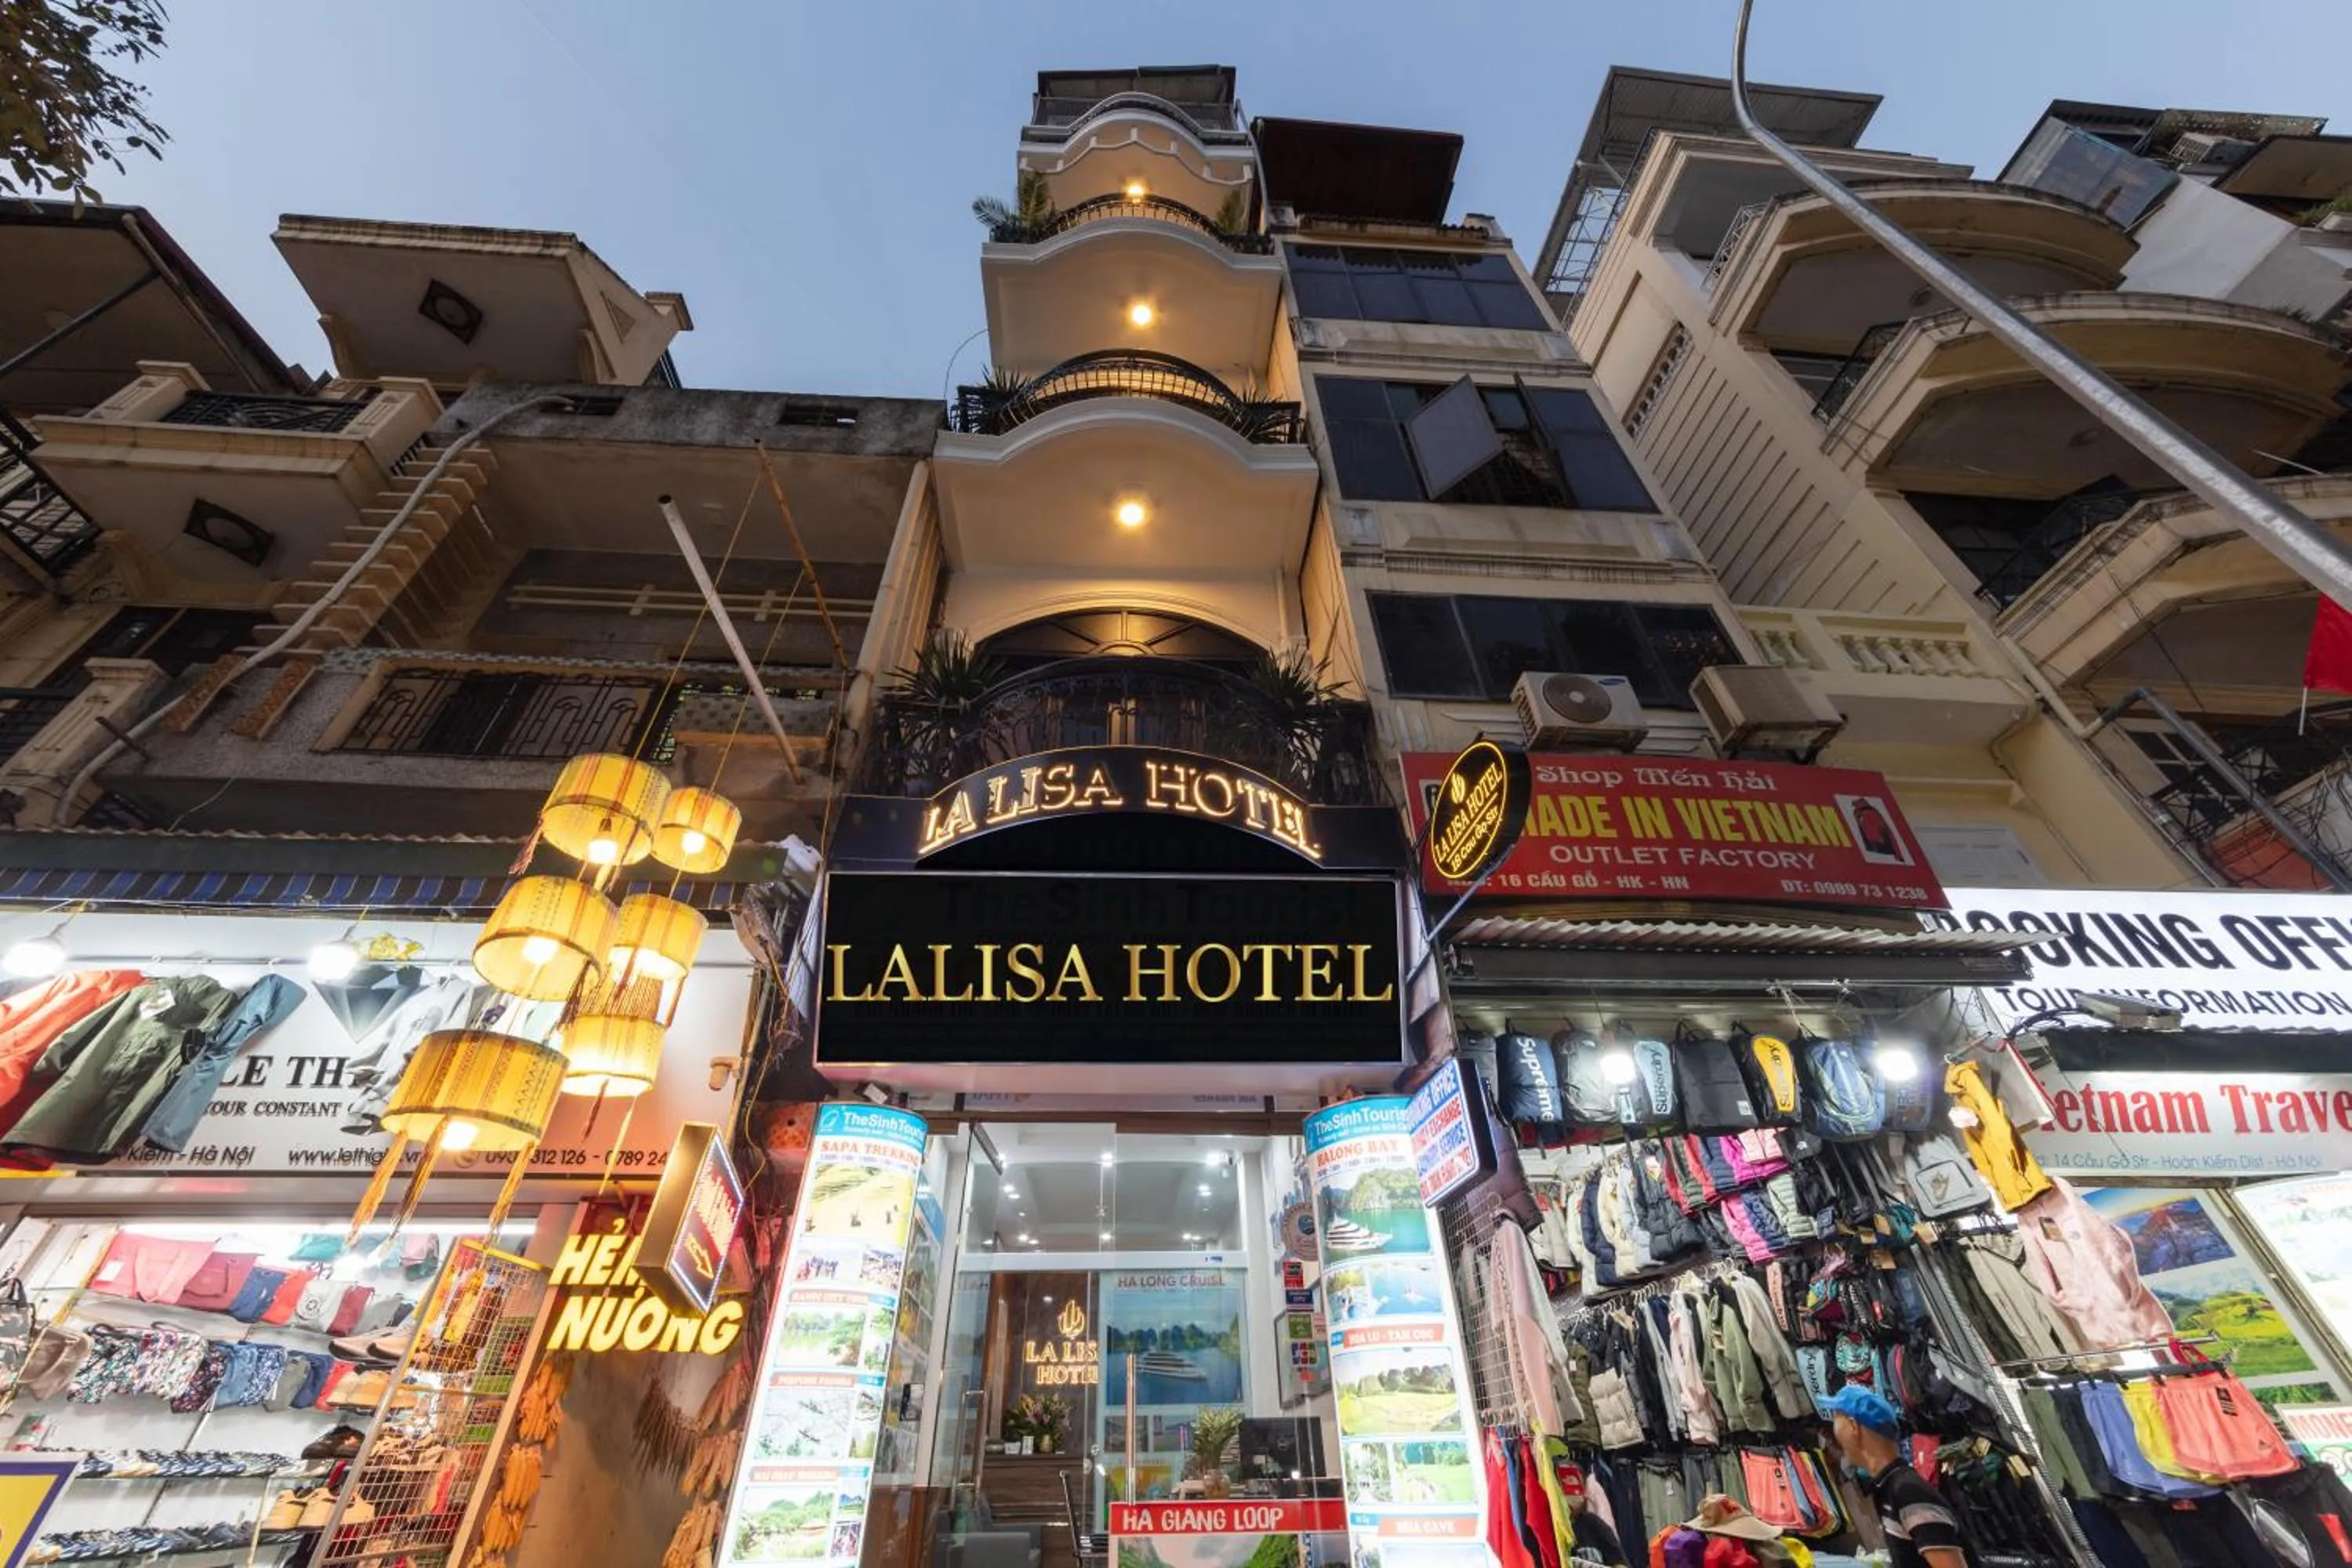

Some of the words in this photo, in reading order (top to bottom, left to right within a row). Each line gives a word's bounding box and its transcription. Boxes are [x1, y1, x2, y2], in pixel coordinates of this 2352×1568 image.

[1535, 765, 1624, 788] Shop
[918, 789, 978, 855] LA
[985, 764, 1124, 825] LISA
[1145, 760, 1322, 860] HOTEL
[1434, 837, 1450, 863] LA
[1446, 808, 1470, 846] LISA
[1465, 762, 1503, 818] HOTEL
[1621, 796, 1673, 840] IN
[1673, 797, 1853, 848] VIETNAM
[1549, 844, 1668, 866] OUTLET
[1679, 848, 1816, 870] FACTORY
[1498, 873, 1523, 887] 16
[1615, 875, 1644, 889] HK
[2219, 914, 2352, 971] OFFI
[826, 943, 1105, 1003] LALISA
[1122, 943, 1394, 1002] HOTEL
[252, 1102, 343, 1117] CONSTANT
[2041, 1083, 2210, 1134] etnam
[561, 1149, 586, 1164] 126
[1140, 1275, 1176, 1288] LONG
[1025, 1341, 1058, 1362] LA
[1062, 1340, 1099, 1362] LIS
[1160, 1508, 1226, 1531] GIANG
[1233, 1505, 1284, 1530] LOOP
